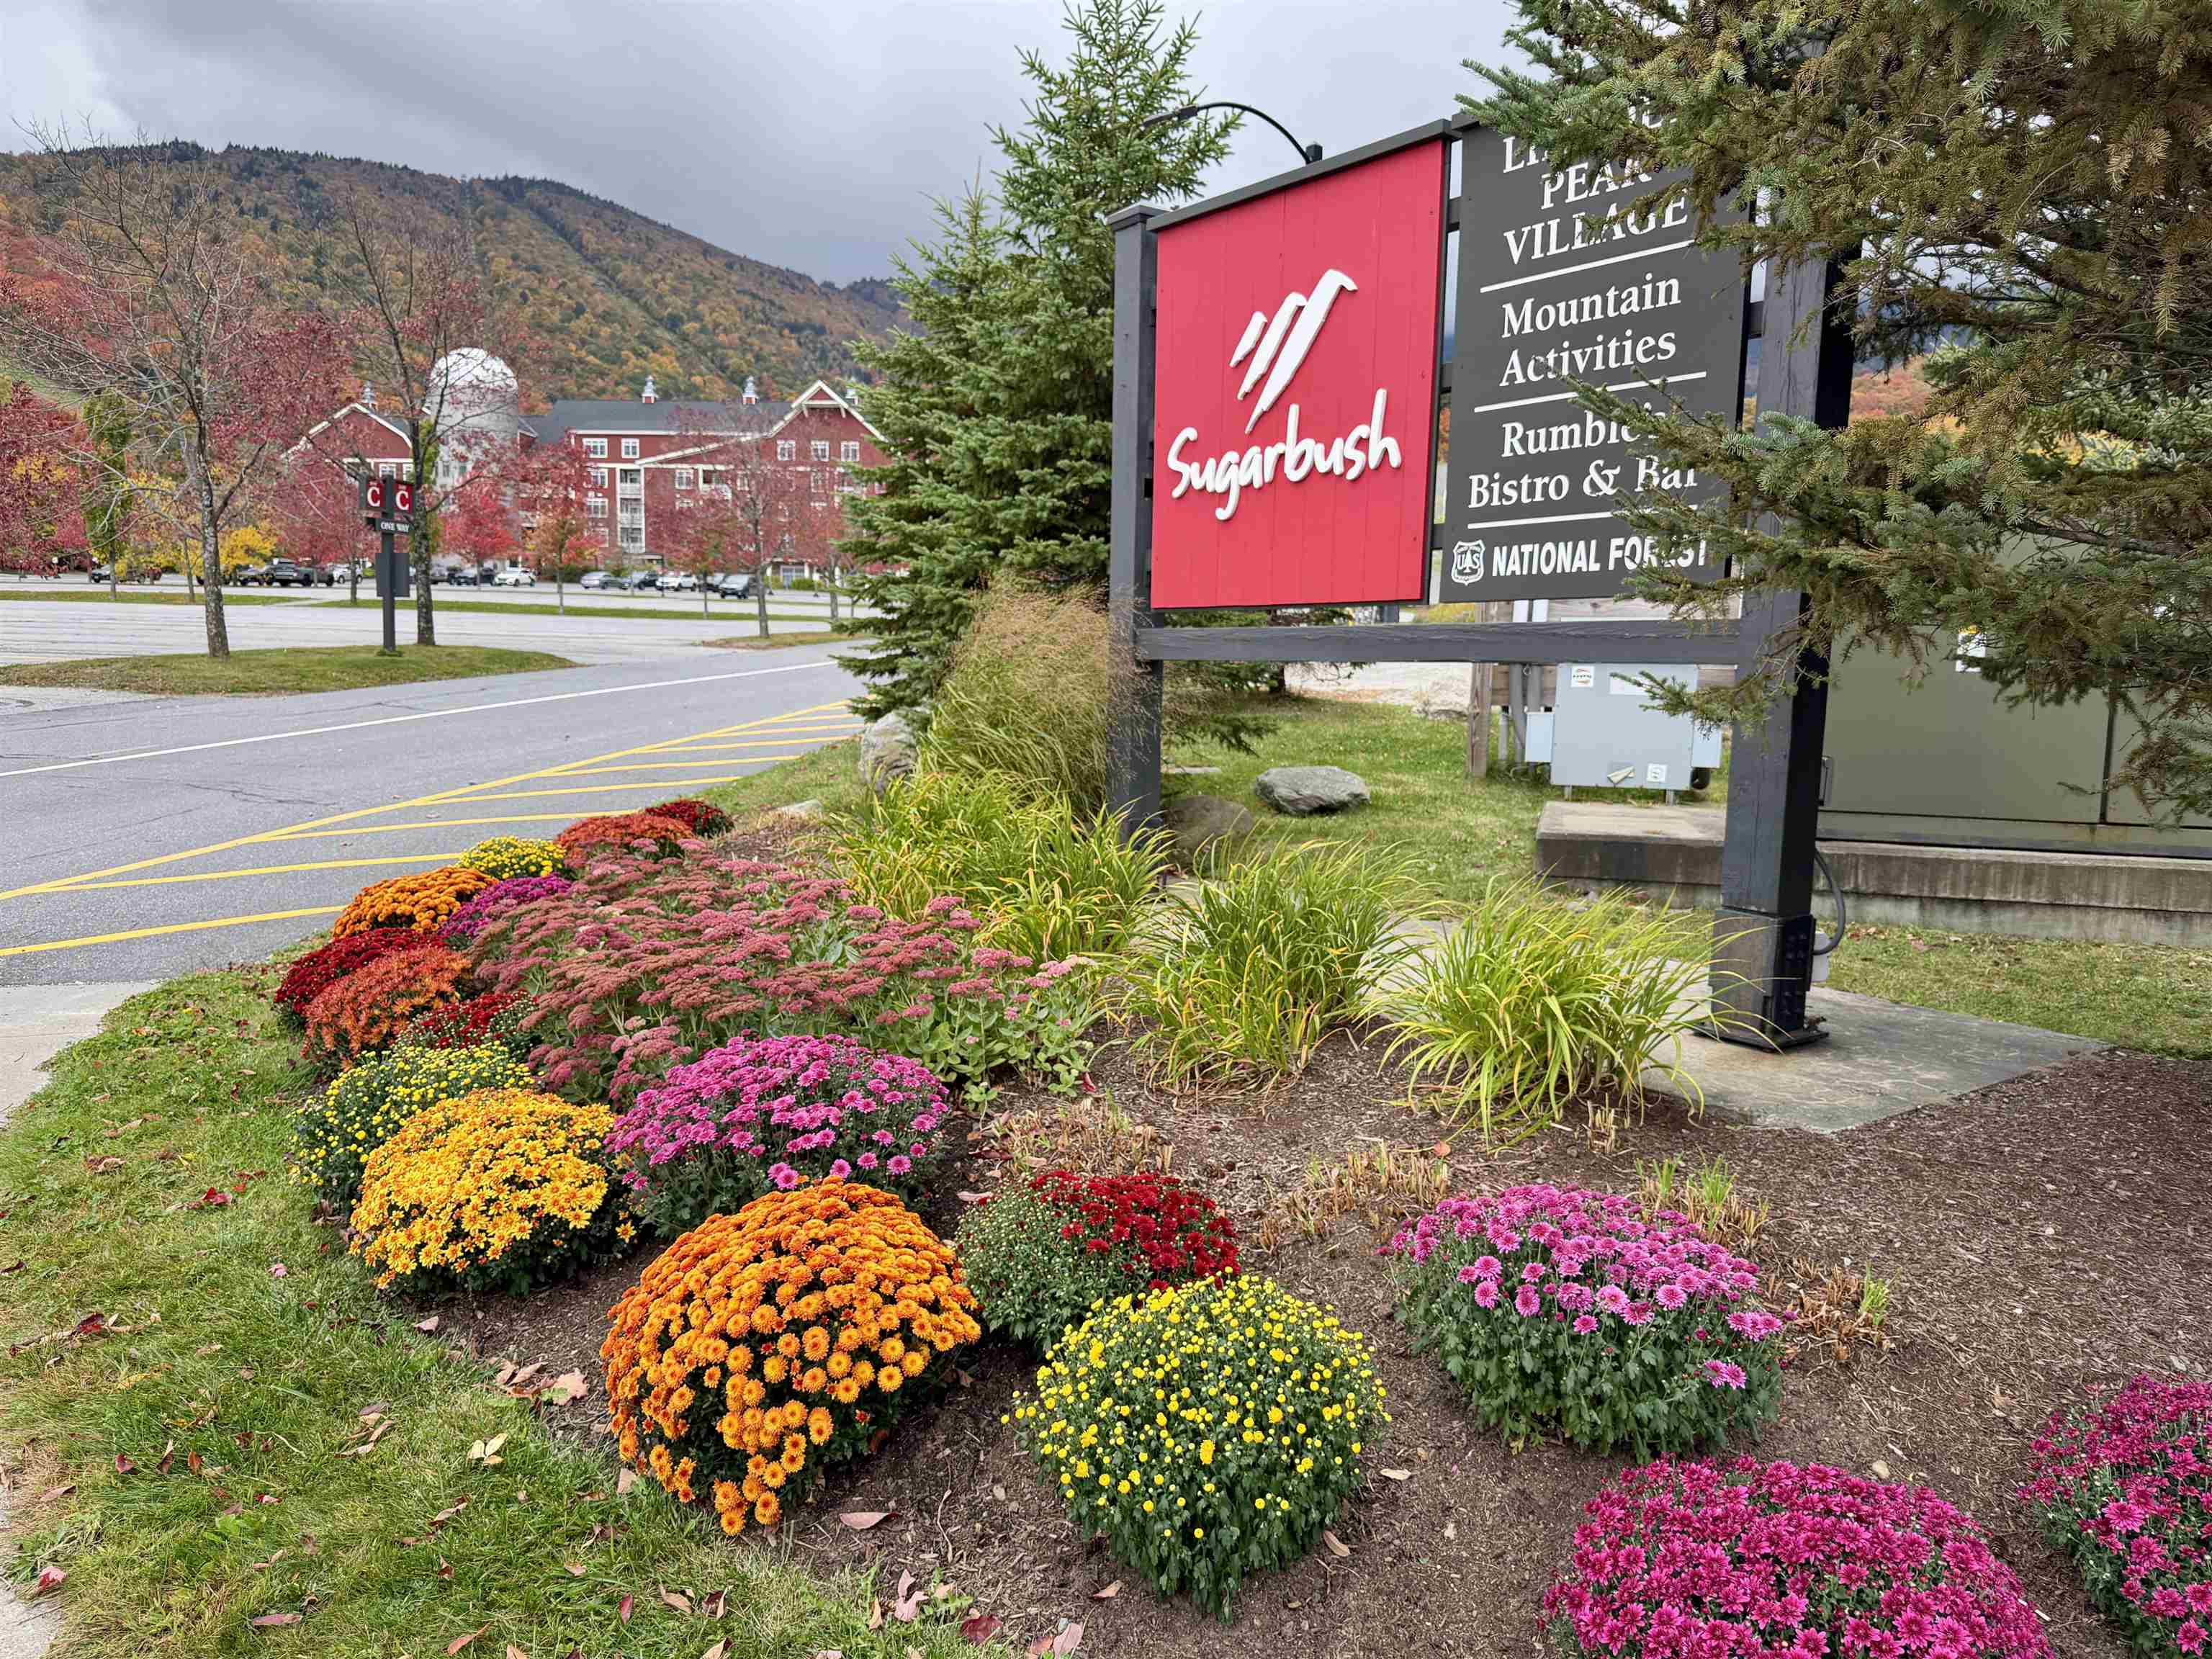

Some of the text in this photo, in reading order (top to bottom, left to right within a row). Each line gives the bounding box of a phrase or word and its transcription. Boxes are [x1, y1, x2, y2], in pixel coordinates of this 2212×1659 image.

[1503, 188, 1689, 265] VILLAGE
[1501, 272, 1682, 339] Mountain
[1498, 328, 1677, 387] Activities
[1167, 387, 1402, 521] Sugarbush
[1501, 402, 1665, 458] Rumbl'
[367, 486, 381, 507] C
[395, 490, 410, 511] C
[1467, 454, 1699, 509] Bistro & Bar
[380, 521, 410, 533] ONE WAY
[1492, 534, 1707, 577] NATIONAL FORST
